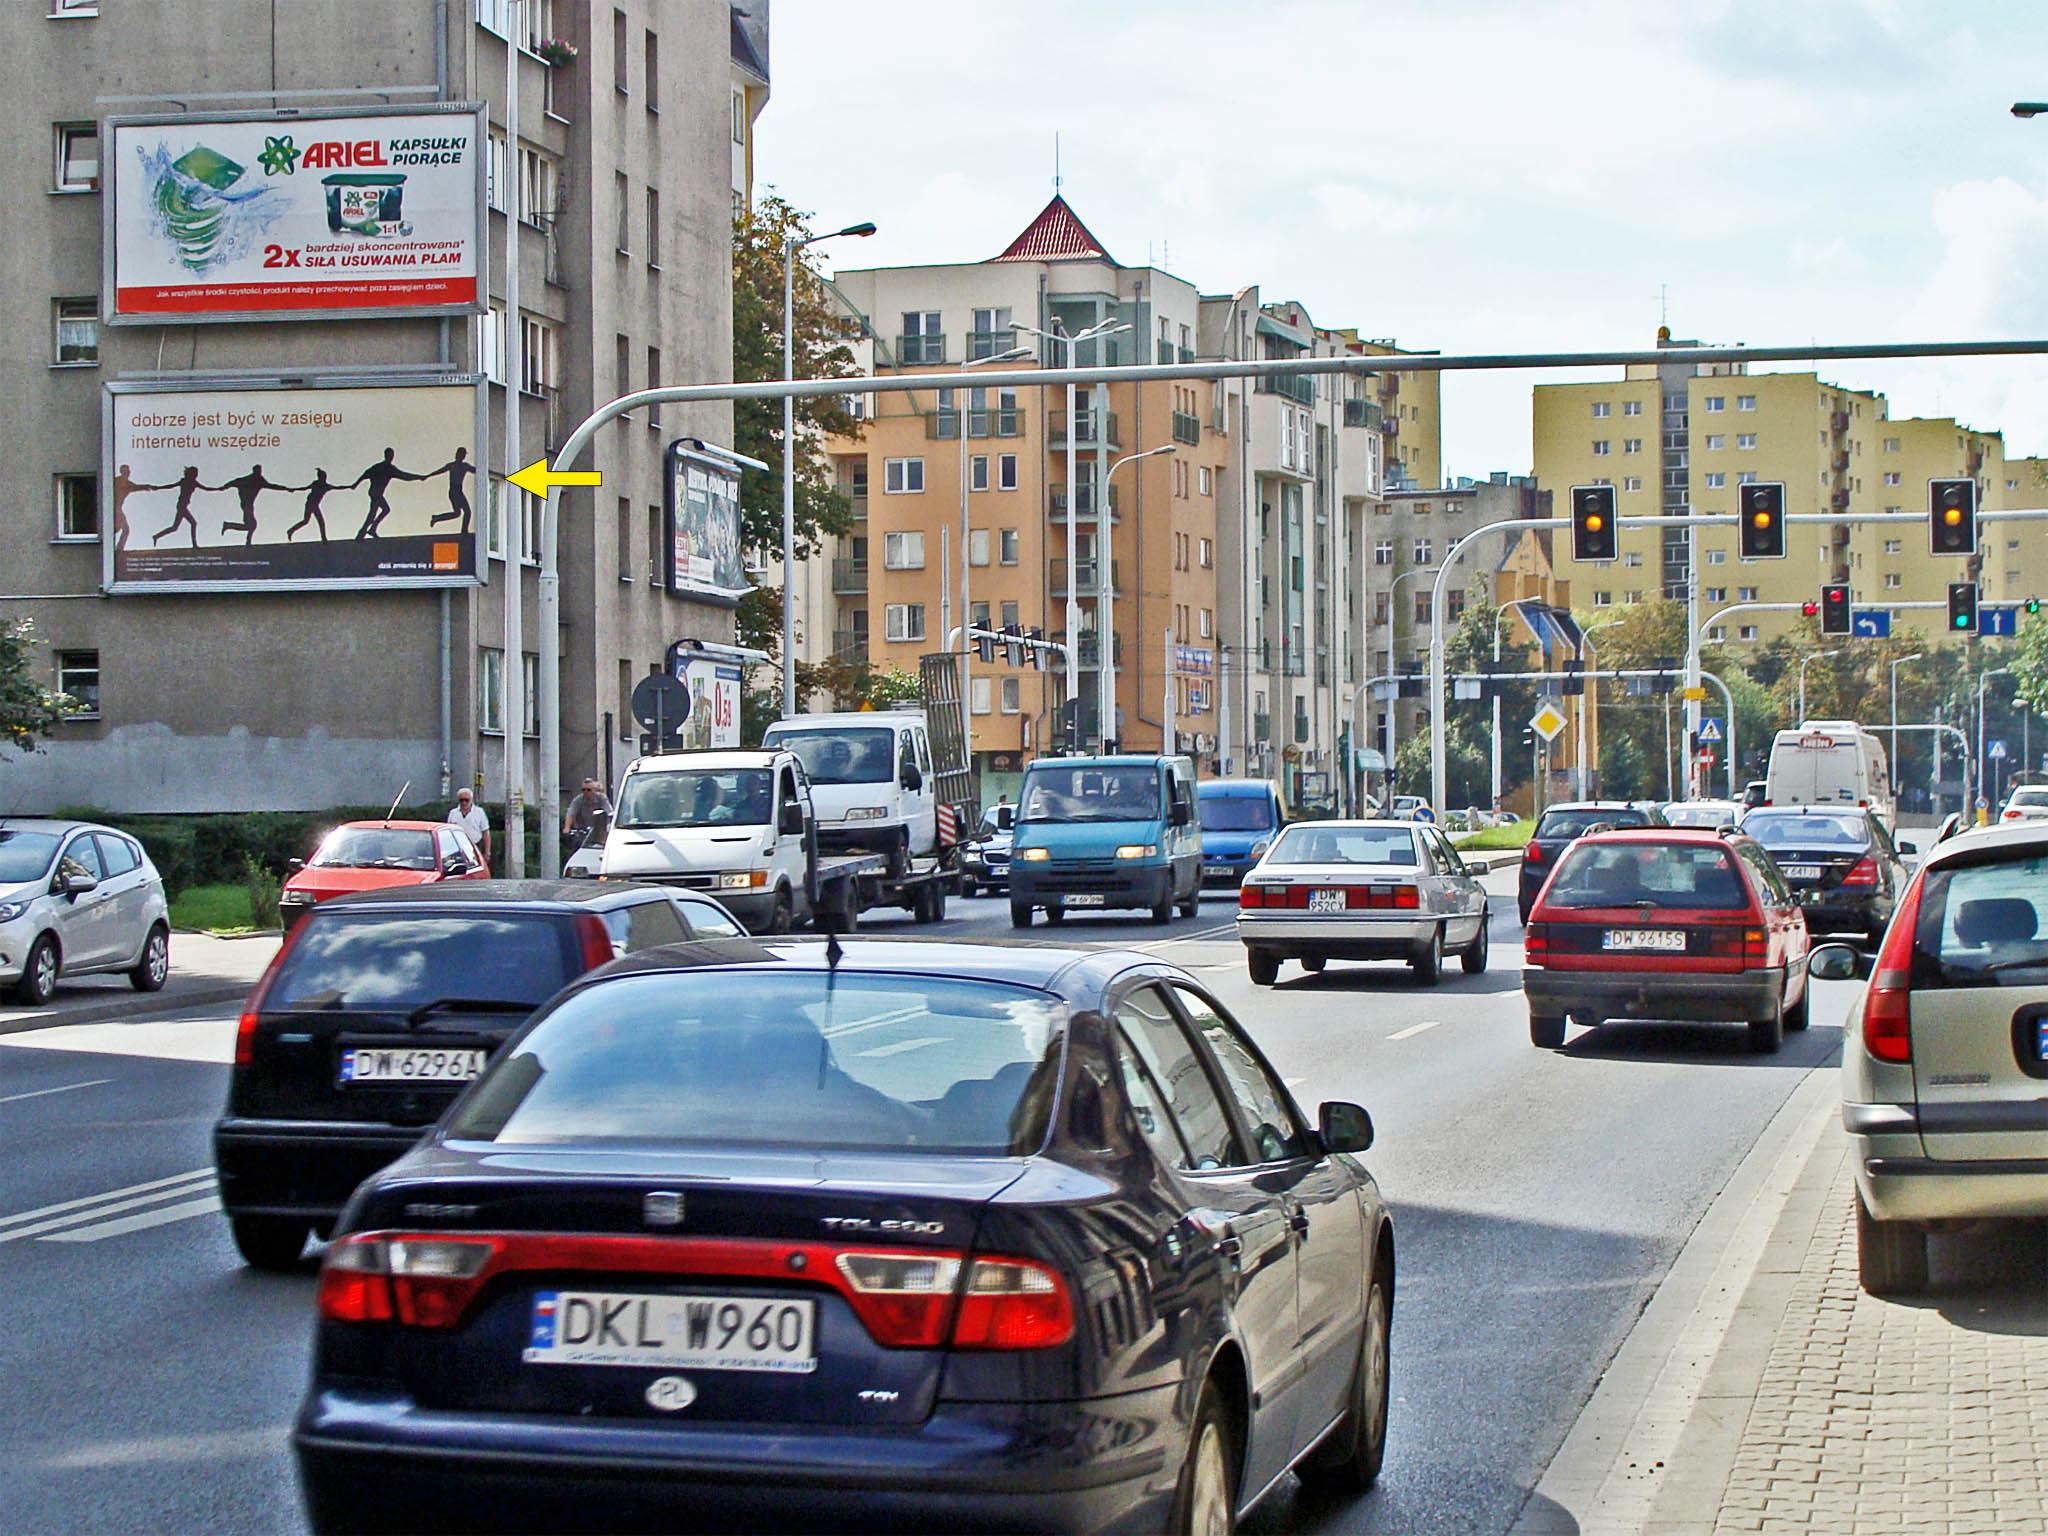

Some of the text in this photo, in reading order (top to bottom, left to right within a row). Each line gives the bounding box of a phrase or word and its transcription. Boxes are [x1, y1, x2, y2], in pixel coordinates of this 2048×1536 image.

[389, 137, 467, 151] KAPSUŁKI
[302, 140, 388, 168] ARIEL
[393, 152, 462, 168] PIORĄCE
[263, 244, 301, 269] 2x
[306, 243, 355, 255] bardziej
[305, 252, 462, 268] SIŁA USUWANIA PLAM
[263, 286, 291, 296] produkt
[370, 283, 387, 292] poza
[131, 410, 343, 430] dobrze jest być w zasięgu
[131, 433, 281, 452] internetu wszędzie
[1320, 889, 1337, 900] DW
[1310, 901, 1344, 912] 952CX
[1612, 931, 1683, 946] DW 9615S
[358, 1052, 480, 1079] DW 6296A
[562, 1298, 803, 1353] DKL W960
